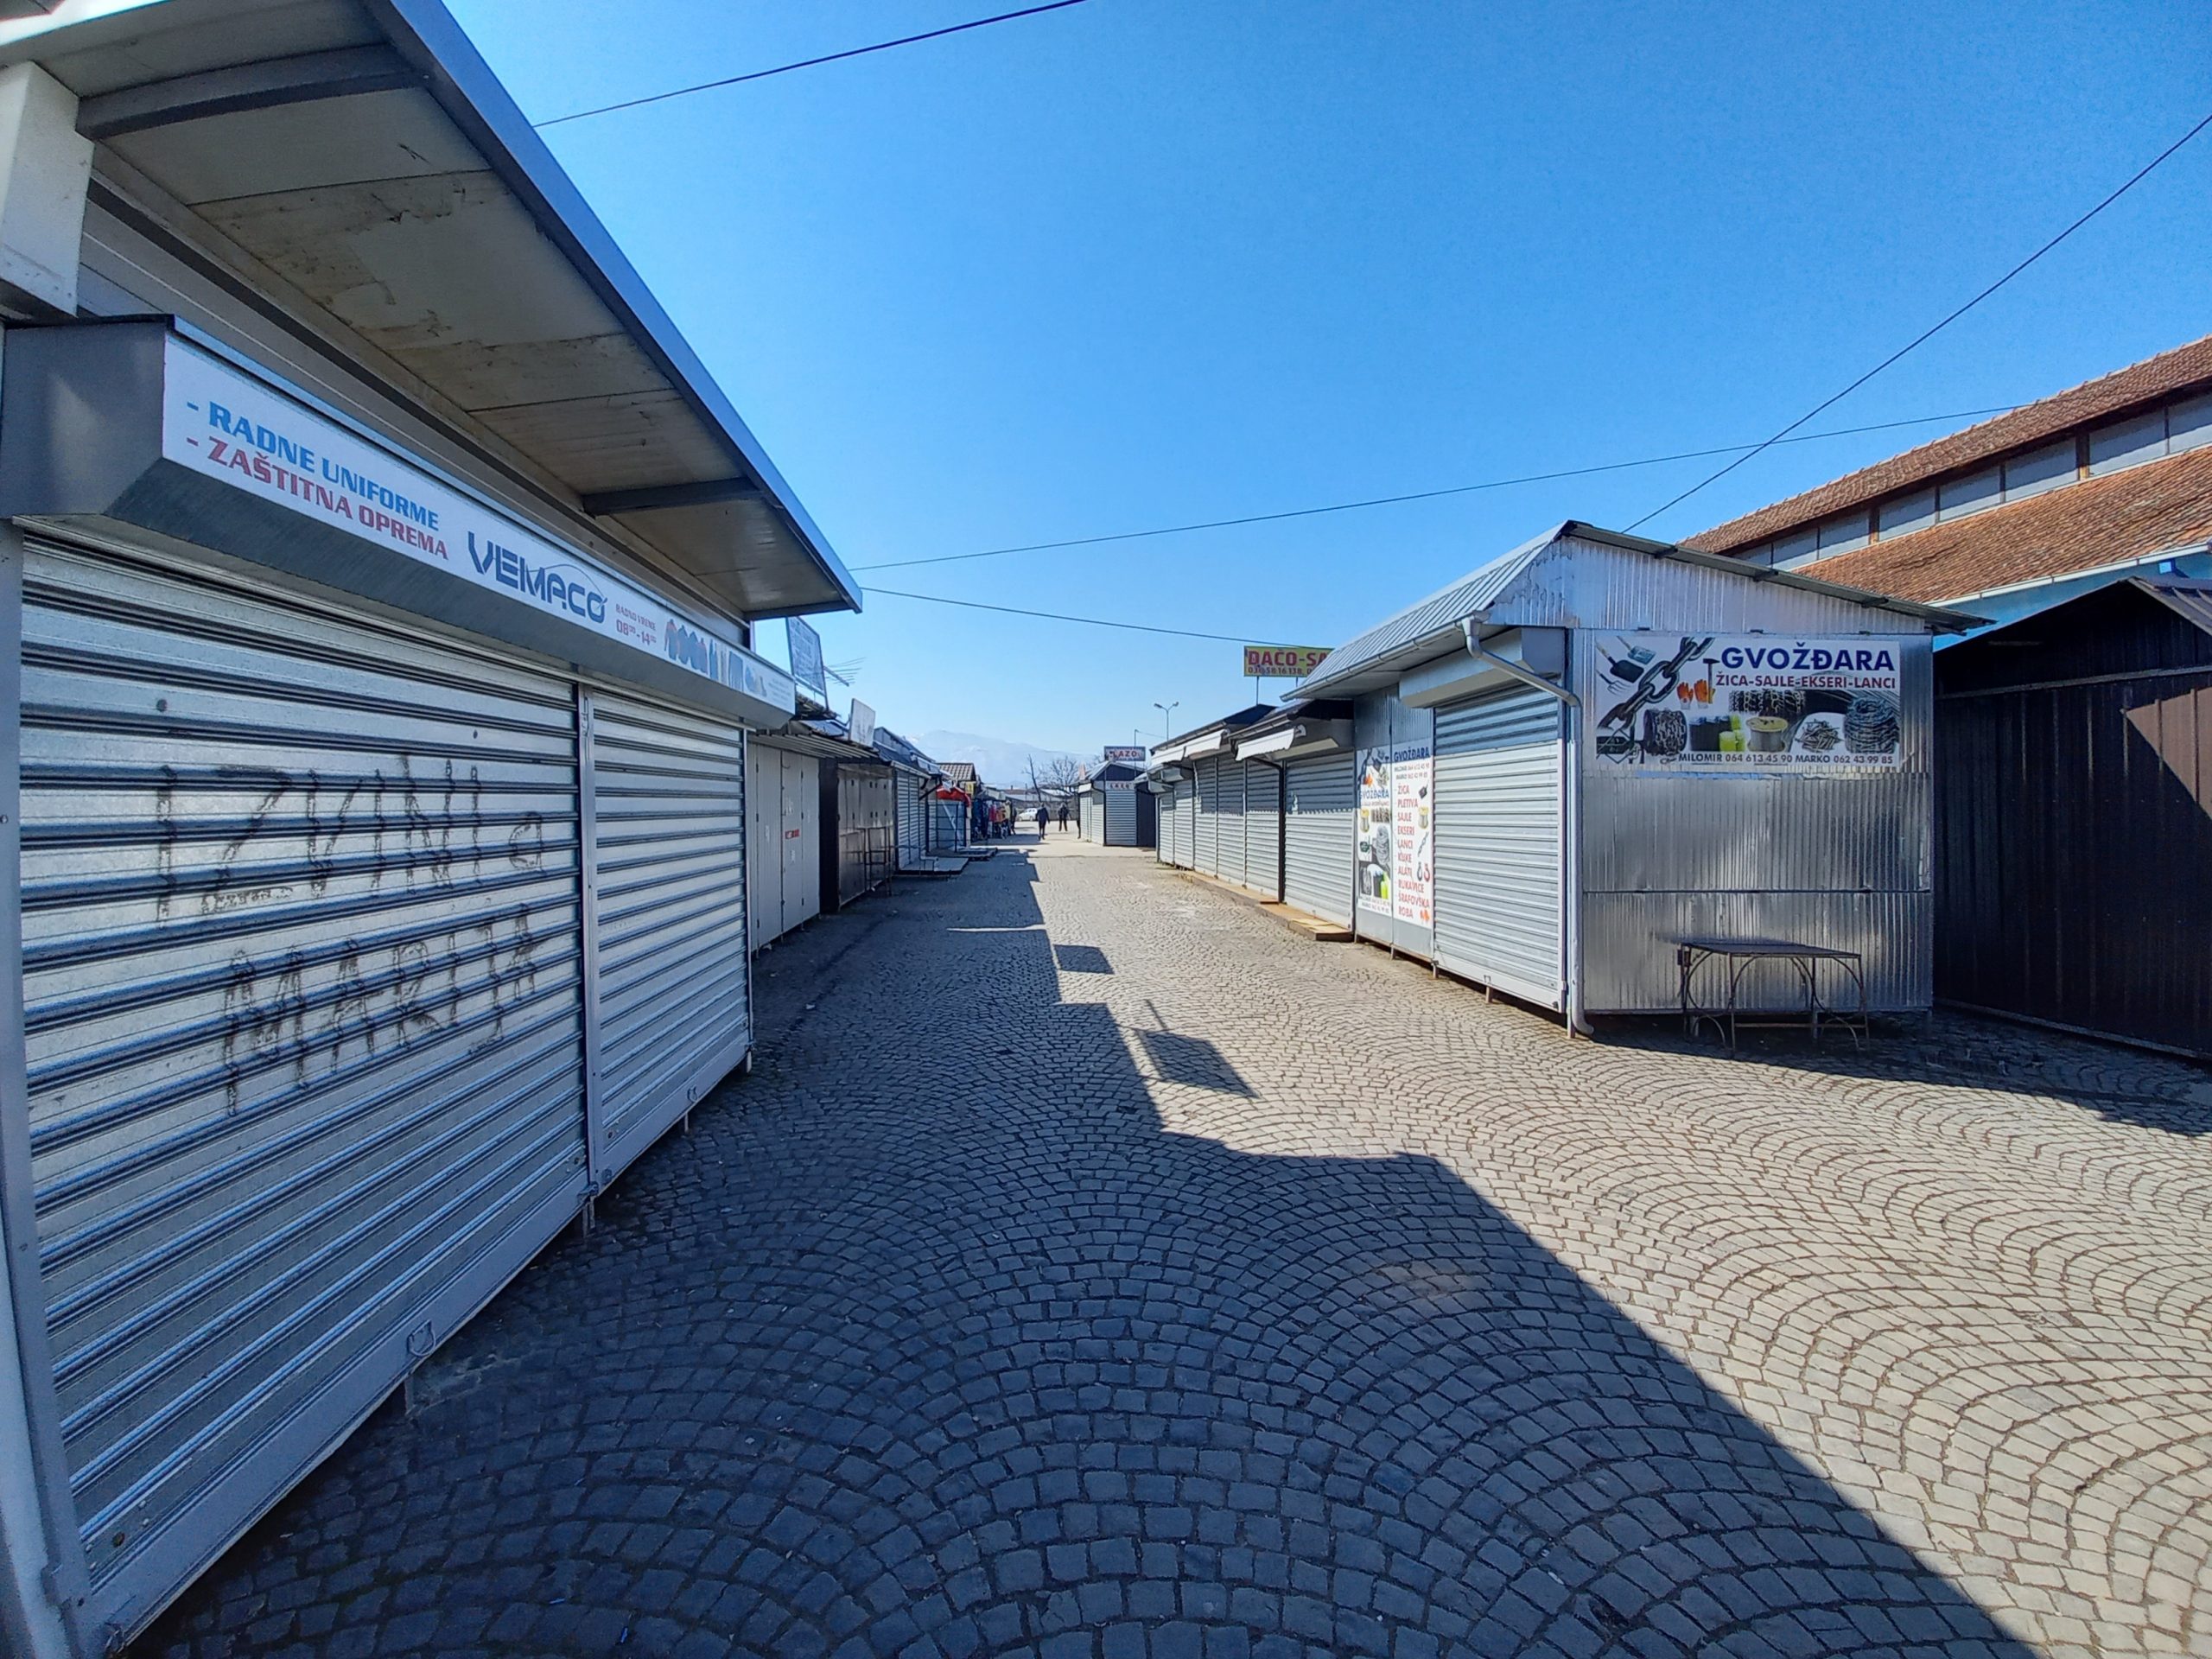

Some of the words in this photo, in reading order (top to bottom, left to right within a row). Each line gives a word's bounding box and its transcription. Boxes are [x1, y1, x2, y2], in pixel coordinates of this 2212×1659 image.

[207, 436, 353, 519] ZAŠTITNA
[359, 506, 449, 561] OPREMA
[209, 401, 315, 474] RADNE
[322, 457, 439, 532] UNIFORME
[467, 531, 607, 624] VEMACO
[1720, 641, 1895, 671] GVOŽĐARA
[1679, 753, 1723, 762] MILOMIR
[1726, 753, 1743, 762] 064
[1745, 753, 1764, 763] 613
[1766, 754, 1778, 763] 45
[1781, 754, 1793, 763] 90
[1796, 754, 1831, 764] MARKO
[1834, 755, 1851, 764] 062
[1853, 755, 1865, 764] 43
[1867, 755, 1879, 764] 99
[1881, 755, 1893, 765] 85
